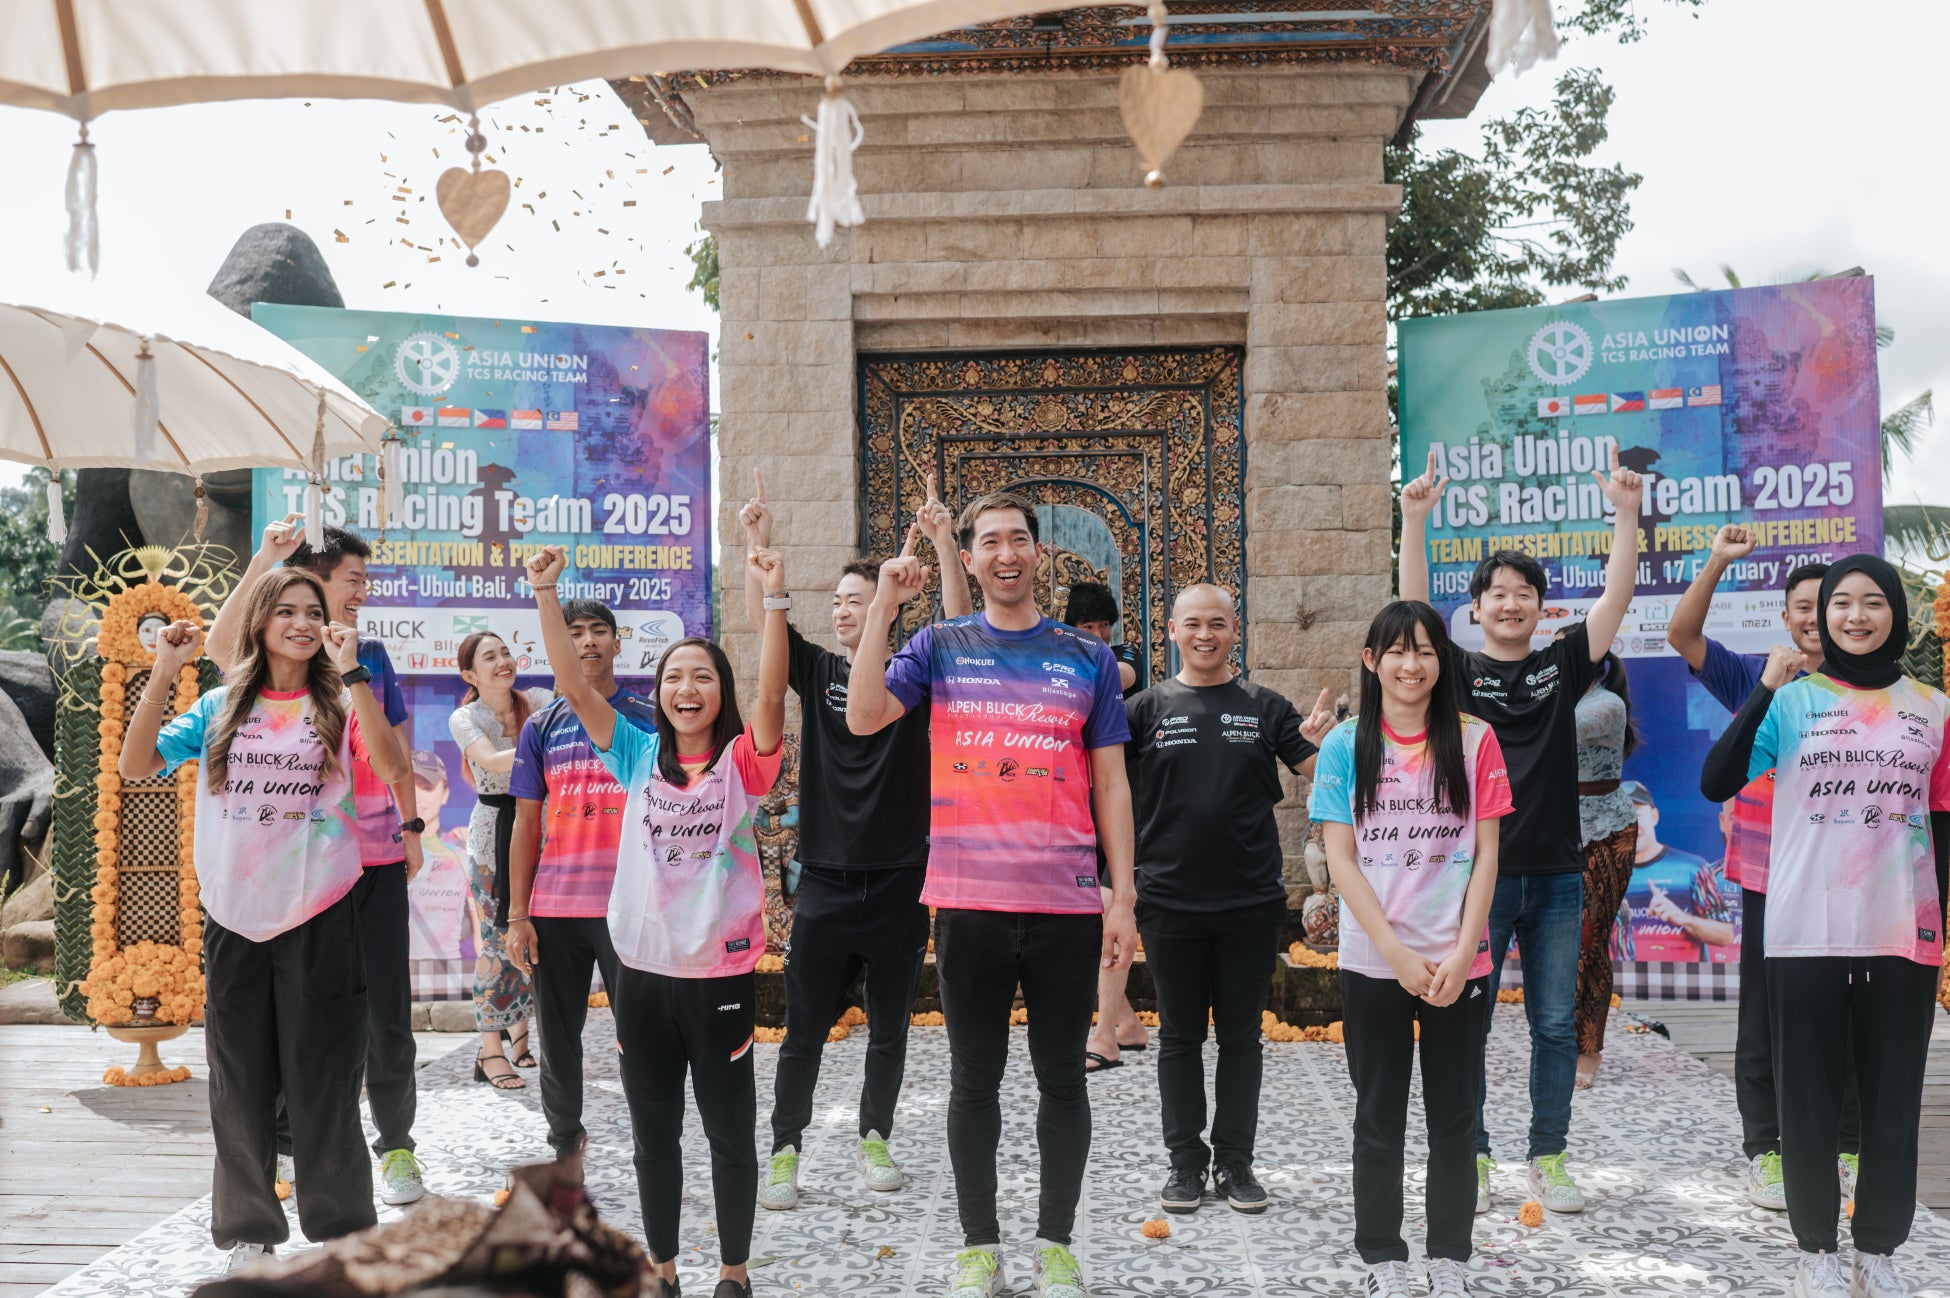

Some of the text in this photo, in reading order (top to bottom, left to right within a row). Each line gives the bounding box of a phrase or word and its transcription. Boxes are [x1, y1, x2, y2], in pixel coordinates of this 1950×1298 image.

[1601, 324, 1729, 350] ASIA UNION
[467, 351, 588, 371] ASIA UNION
[1601, 341, 1729, 364] TCS RACING TEAM
[467, 367, 588, 384] TCS RACING TEAM
[376, 439, 478, 484] nion
[1428, 430, 1617, 482] Asia Union
[1641, 474, 1741, 516] Team
[1753, 461, 1854, 510] 2025
[283, 486, 691, 537] TS Rcing Team 2025
[1430, 537, 1482, 563] TEAM
[1488, 531, 1614, 558] PRESENTATIO
[1654, 524, 1717, 552] PRESS
[1729, 517, 1857, 547] NFERENCE
[364, 541, 484, 567] ESENTATION
[510, 544, 570, 568] PRS
[576, 544, 692, 570] CONFERENCE
[1663, 560, 1685, 584] 17
[365, 575, 466, 597] esort-Ubud
[472, 576, 511, 600] Bali,
[557, 577, 624, 606] ebruary
[629, 578, 671, 600] 2025
[367, 620, 425, 639] BLICK
[965, 657, 995, 666] HOKUEI
[957, 677, 1002, 685] HONDA
[947, 701, 1078, 726] ALPEN BLICK Resort
[1814, 710, 1848, 719] HOKUEI
[234, 732, 264, 740] ONDA
[956, 730, 1070, 752] ASIA UNION
[1811, 728, 1858, 737] HONDA
[552, 741, 584, 752] HONDA
[1164, 738, 1197, 747] HONDA
[247, 753, 282, 765] BLICK
[1800, 749, 1930, 774] ALPEN BLICK Resort
[263, 781, 325, 796] UNION
[1810, 780, 1856, 798] ASIA
[1390, 799, 1424, 811] BLICK
[1408, 825, 1464, 839] UNION
